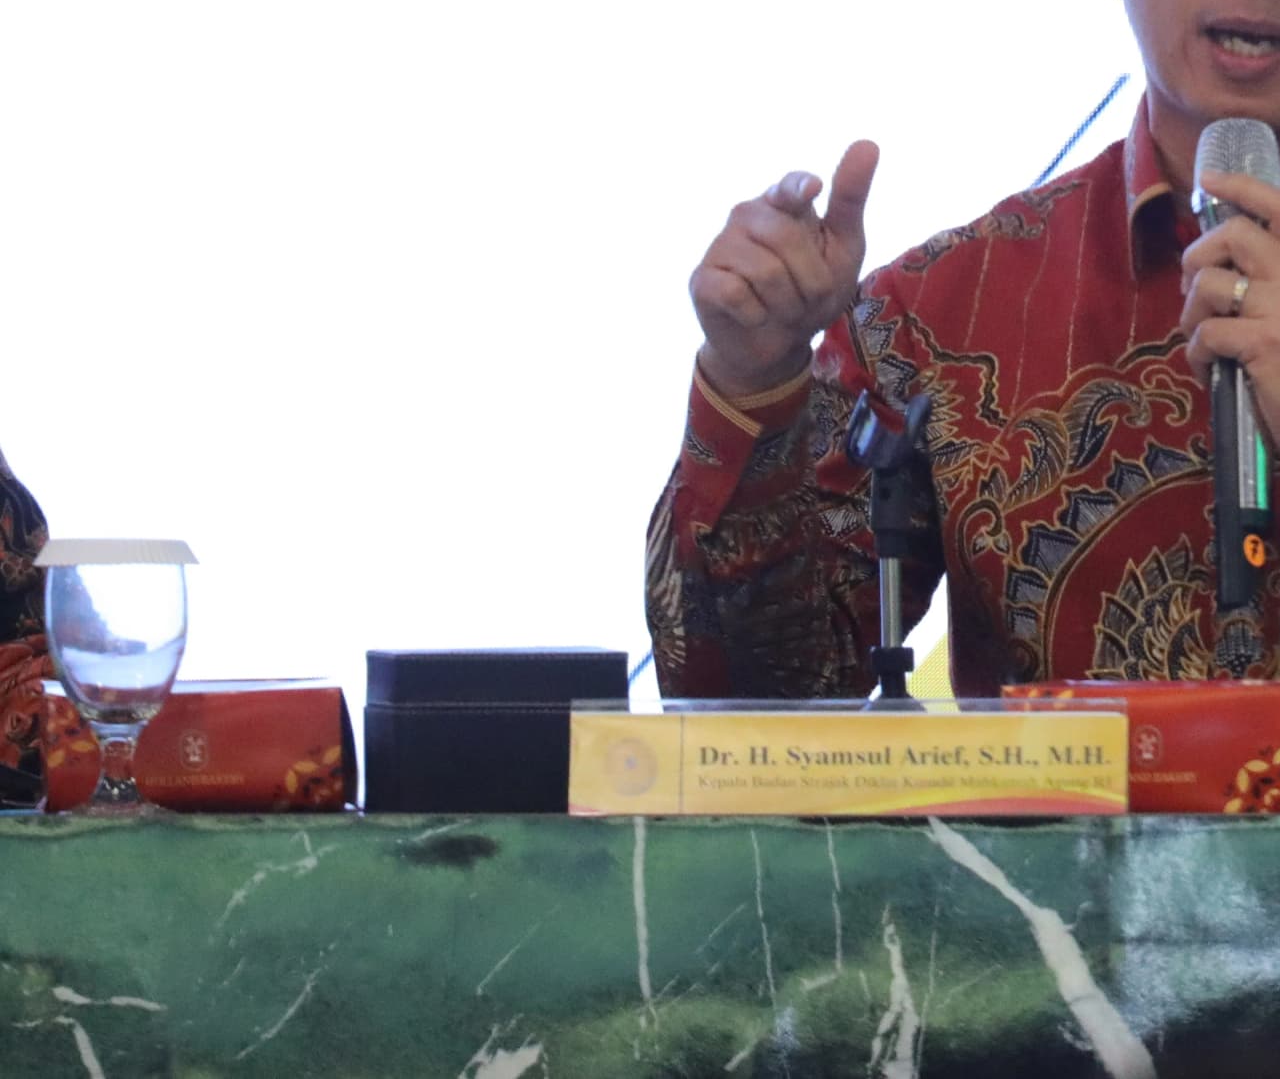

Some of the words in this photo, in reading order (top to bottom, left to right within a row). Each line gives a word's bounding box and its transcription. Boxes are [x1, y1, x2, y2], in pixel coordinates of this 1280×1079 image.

[698, 745, 739, 767] Dr.
[749, 745, 778, 767] H.
[786, 745, 892, 771] Syamsul
[903, 745, 970, 768] Arief,
[978, 745, 1040, 768] S.H.,
[1048, 745, 1112, 767] M.H.
